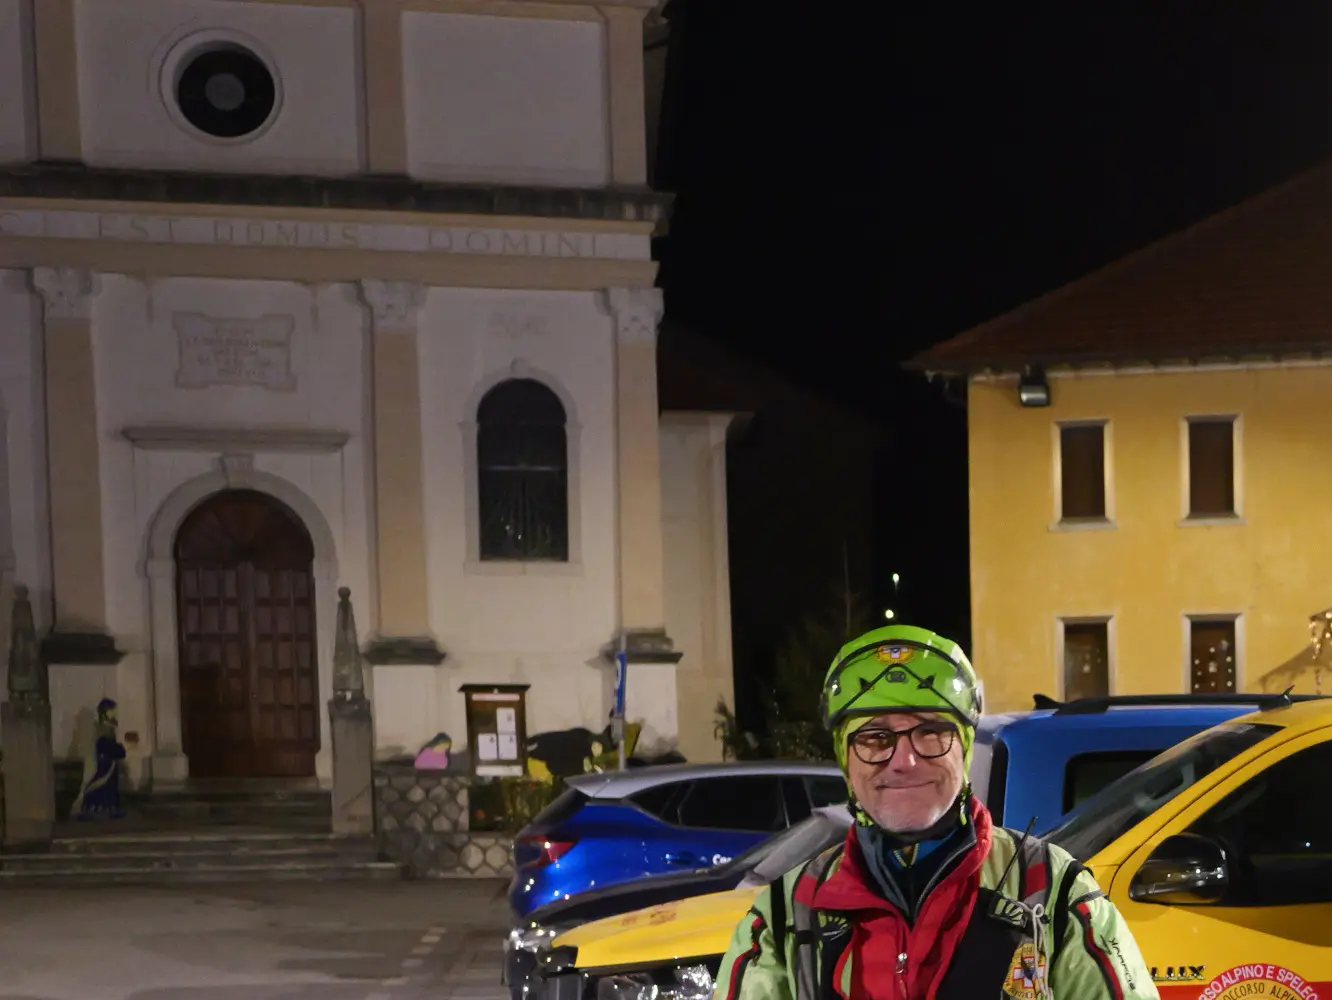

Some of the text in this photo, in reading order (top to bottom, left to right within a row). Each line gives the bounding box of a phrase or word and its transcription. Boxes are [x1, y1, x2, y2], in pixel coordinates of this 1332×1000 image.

[429, 228, 598, 257] DOMINI
[1220, 964, 1264, 988] ALPINO
[1265, 965, 1276, 980] E
